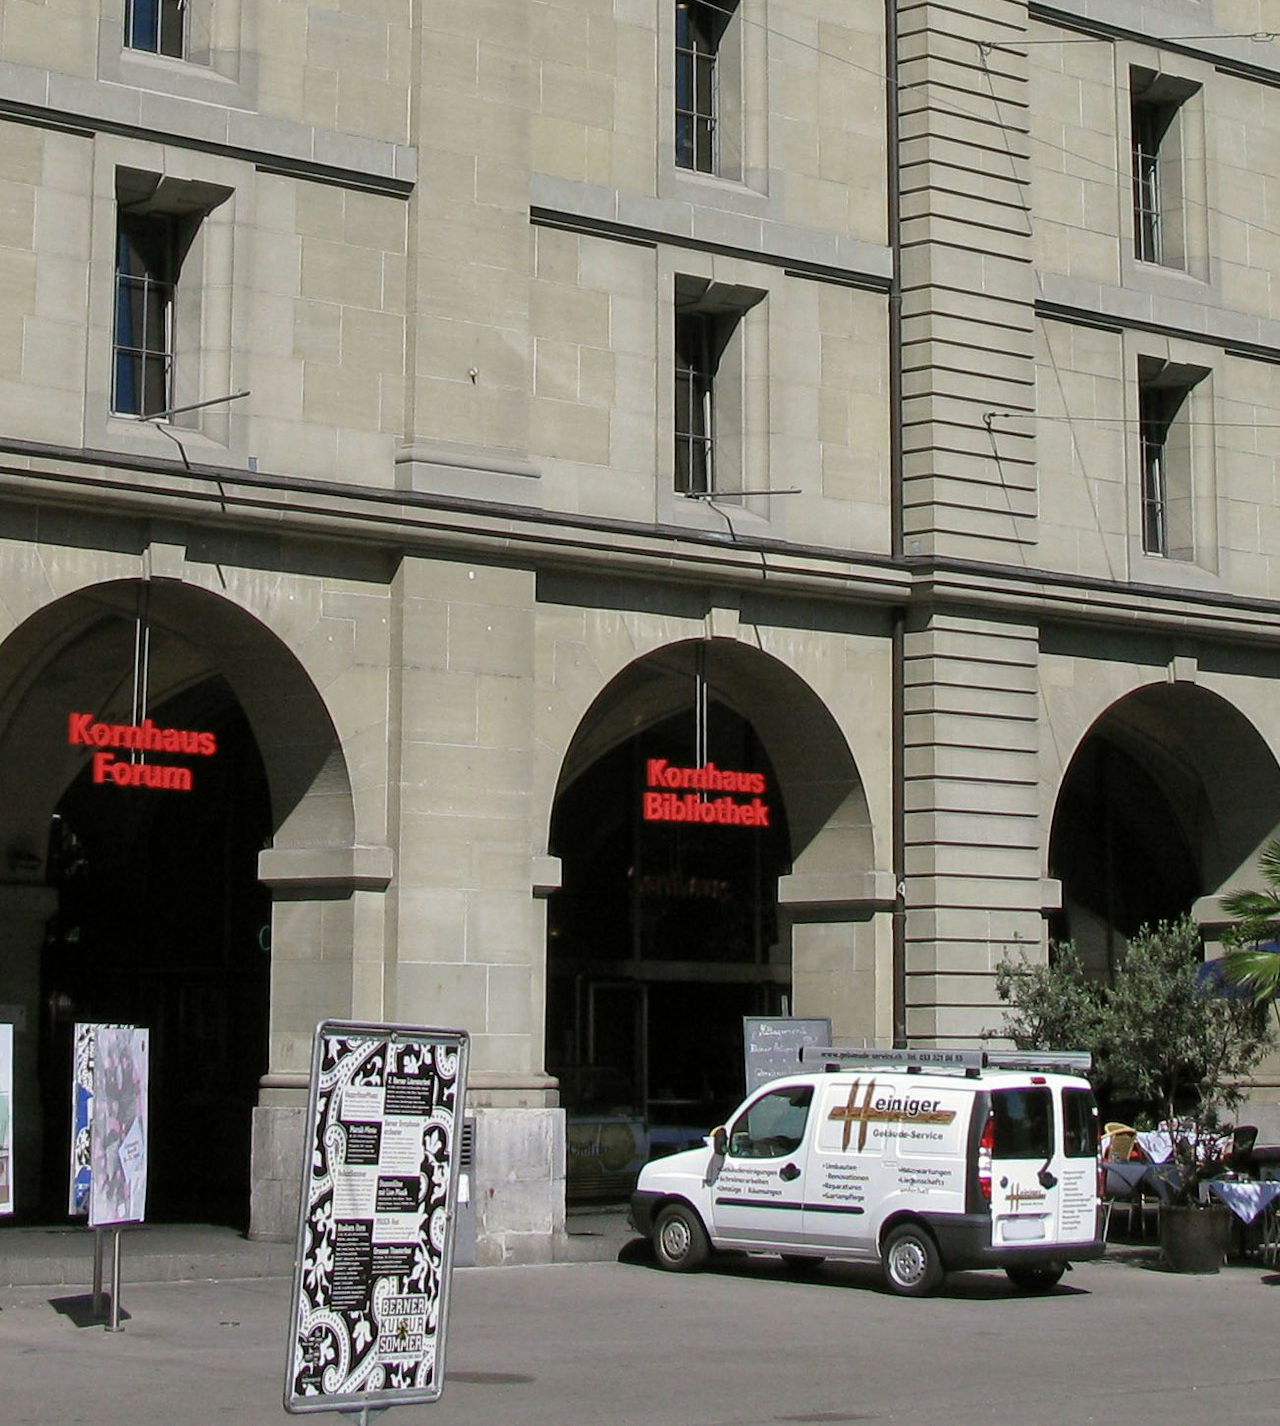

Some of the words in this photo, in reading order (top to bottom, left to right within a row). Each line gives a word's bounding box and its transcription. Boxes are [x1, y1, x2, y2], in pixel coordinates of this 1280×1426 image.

[68, 712, 218, 756] Kornhaus
[93, 751, 193, 791] Forum
[646, 758, 767, 794] Kornhaus
[642, 791, 769, 827] Bibliothek
[873, 1128, 943, 1140] Gebäude-Service
[382, 1298, 424, 1314] BERNER
[379, 1335, 422, 1352] SOMMER
